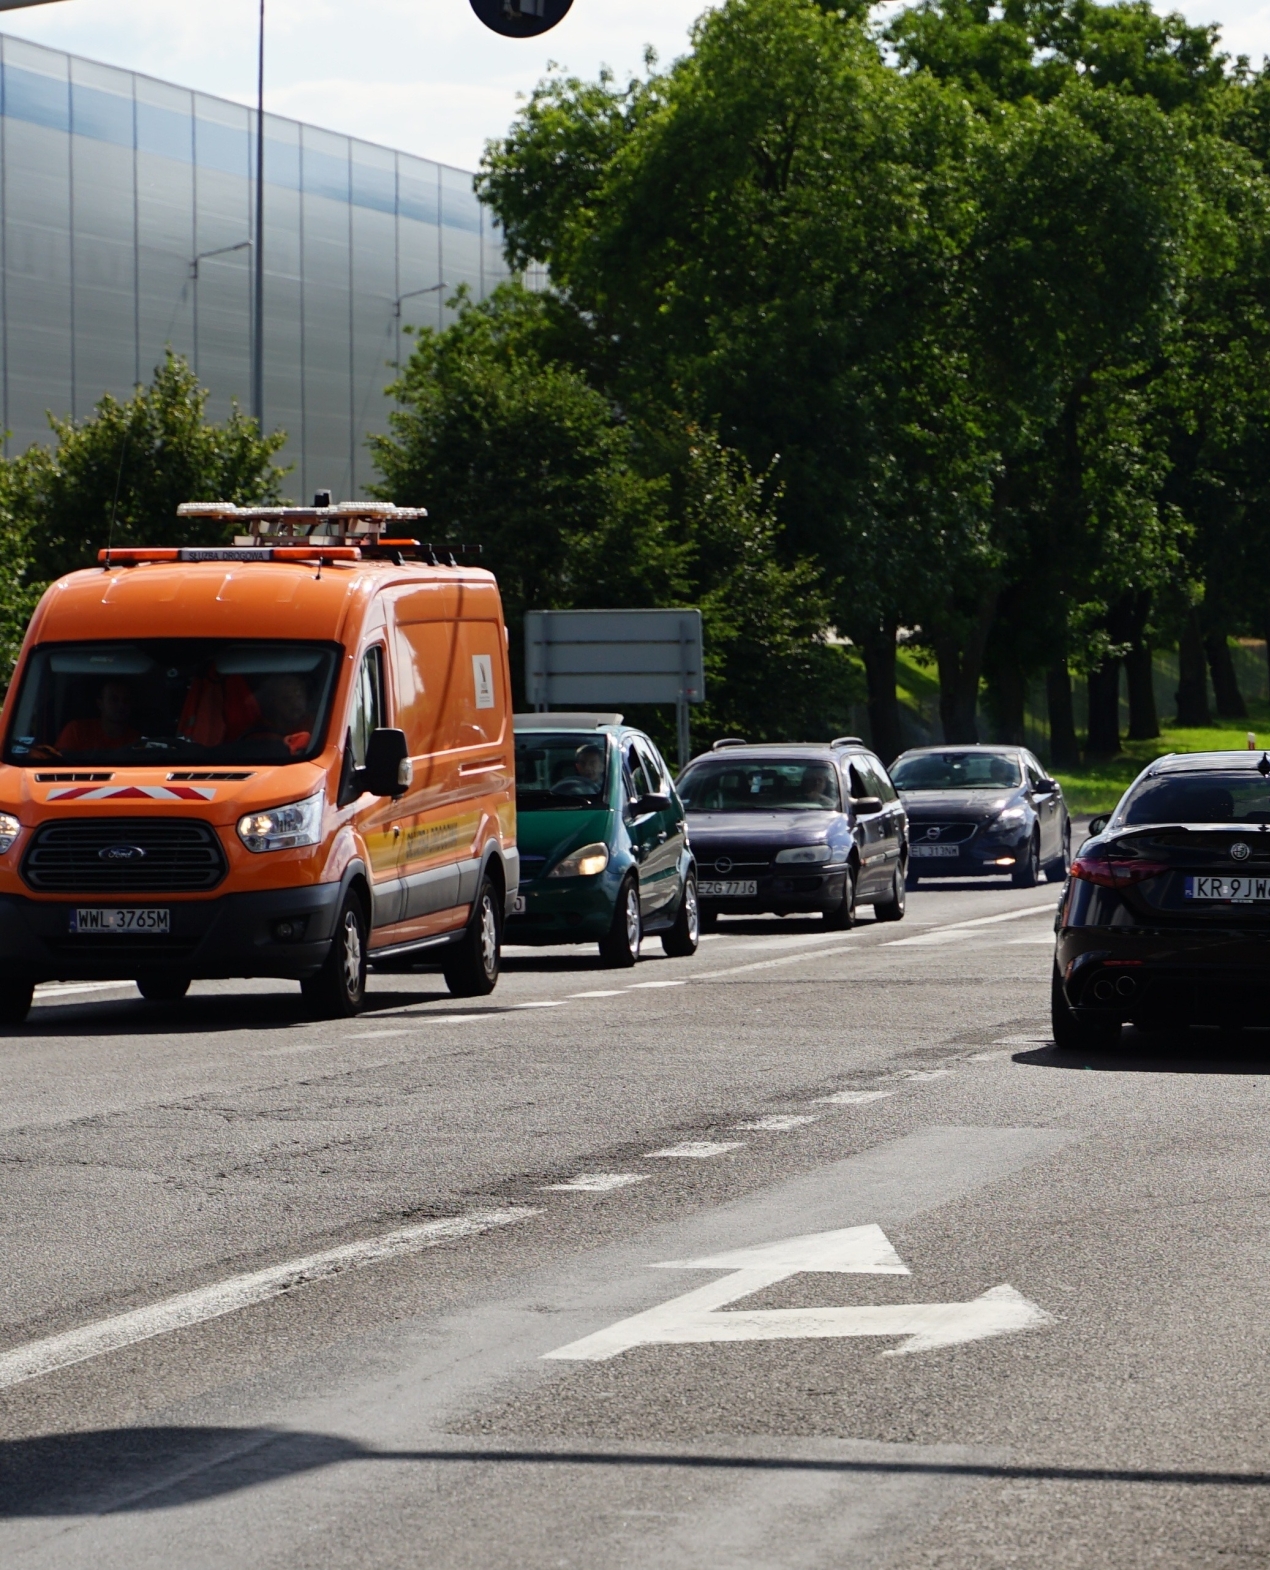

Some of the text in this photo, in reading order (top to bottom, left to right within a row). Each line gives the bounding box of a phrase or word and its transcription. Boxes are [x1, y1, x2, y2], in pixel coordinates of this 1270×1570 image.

[222, 551, 265, 560] DROGOWA
[107, 848, 134, 859] Ford
[911, 846, 925, 856] EL
[697, 882, 755, 894] EZG 77J6
[1197, 878, 1223, 897] KR
[78, 910, 168, 928] WWL 3765M
